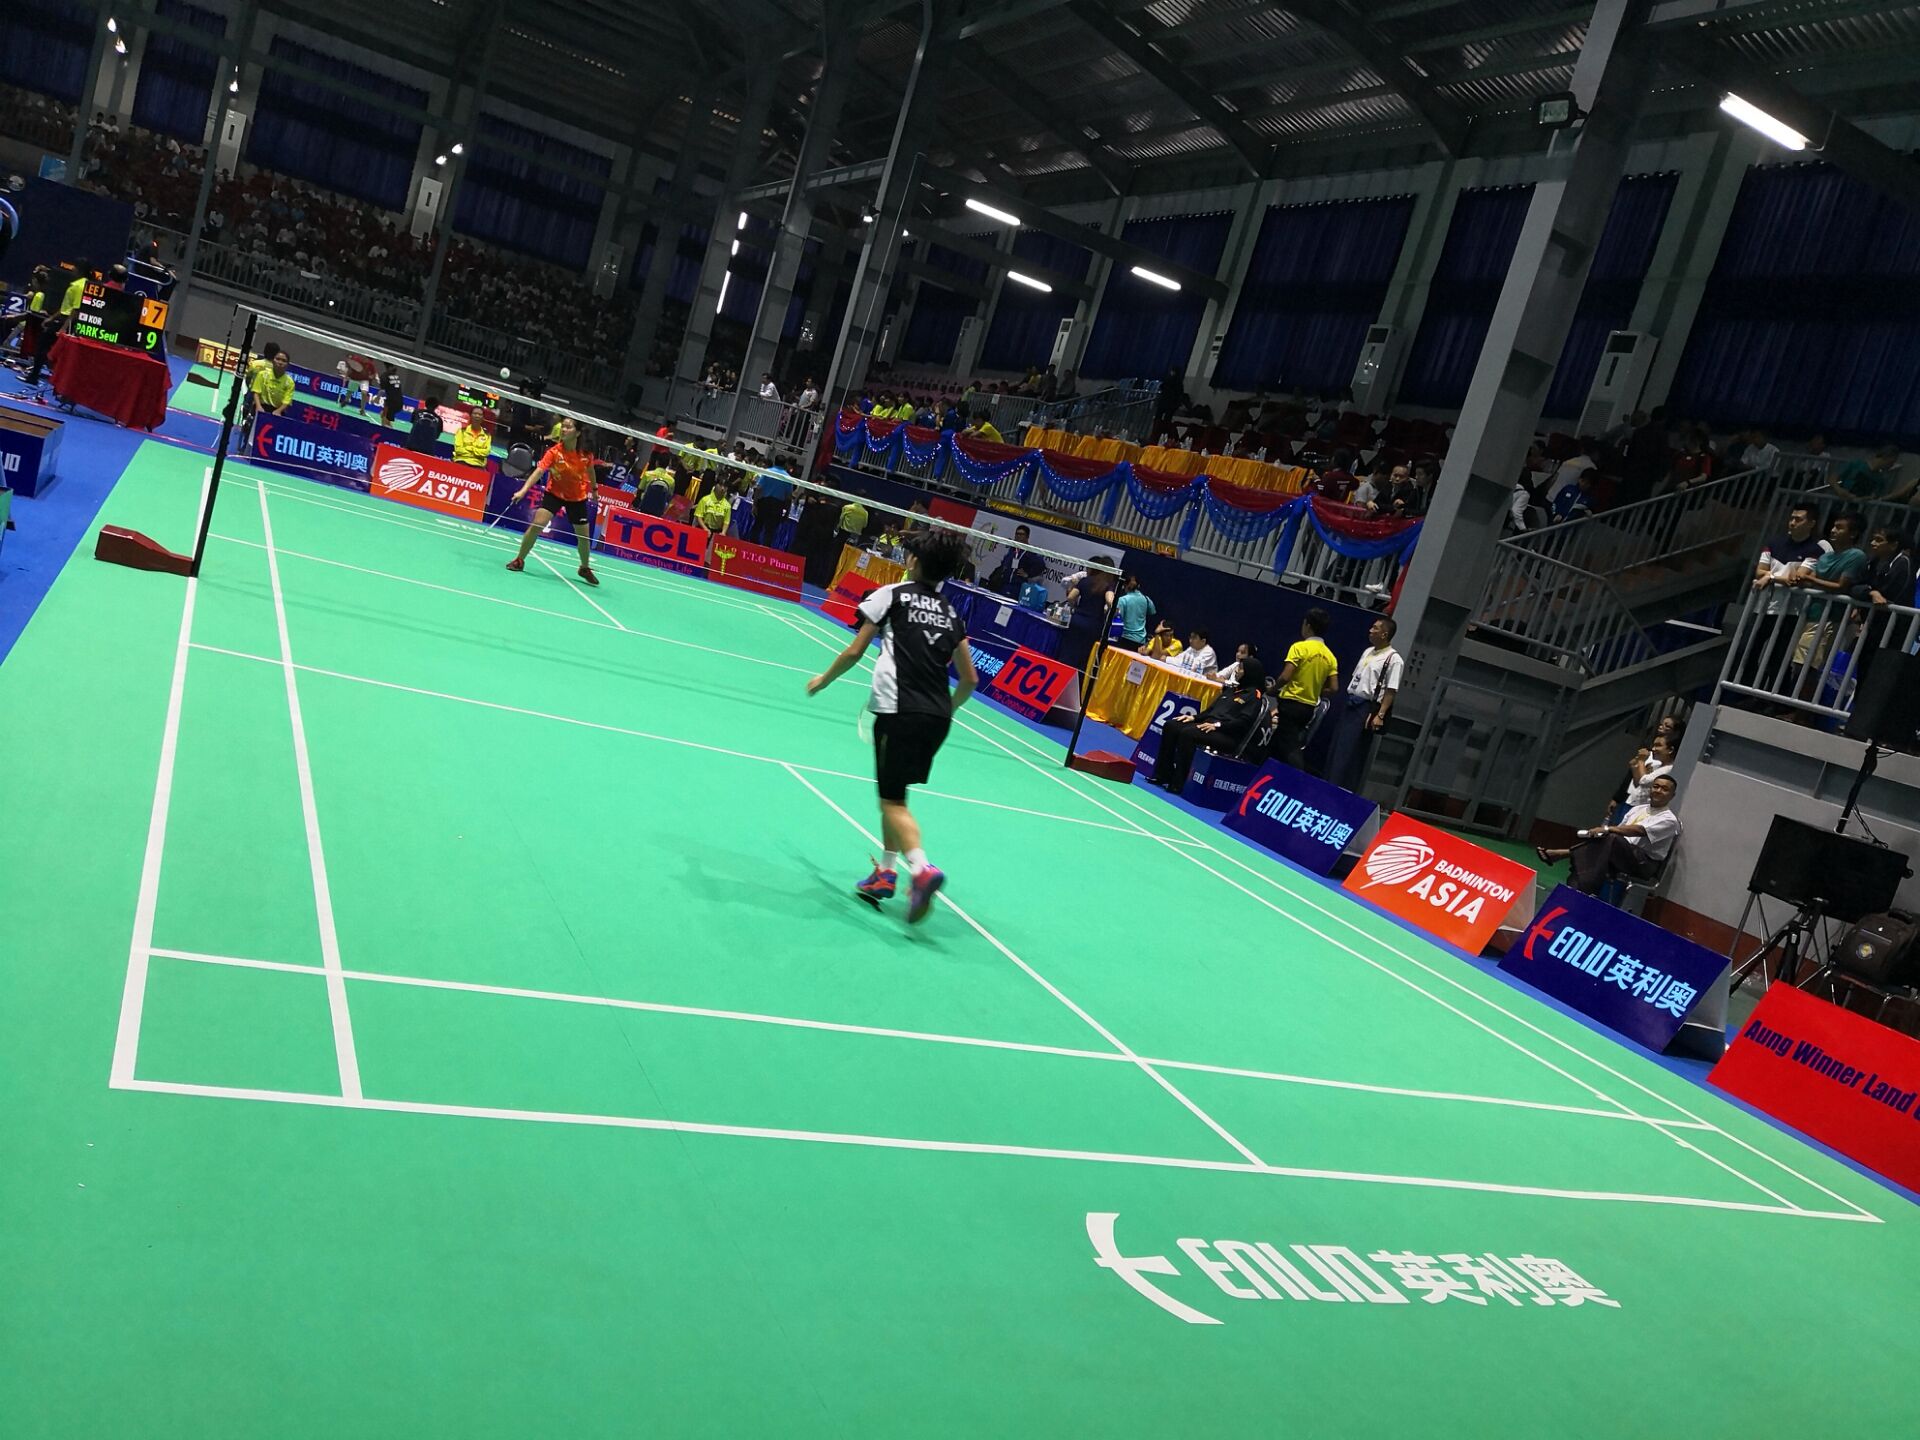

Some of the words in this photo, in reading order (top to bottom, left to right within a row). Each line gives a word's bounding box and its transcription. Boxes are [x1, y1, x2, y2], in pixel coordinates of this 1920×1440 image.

[84, 284, 99, 297] LEE
[91, 299, 106, 309] SGP
[153, 306, 163, 324] 7
[88, 315, 103, 326] KOR
[76, 322, 99, 339] PARK
[98, 329, 119, 344] Seul
[136, 332, 142, 342] 1
[145, 331, 157, 350] 9
[275, 434, 316, 461] ENLIO
[316, 445, 368, 473] 英利奥
[428, 470, 485, 492] BADMINTON
[417, 479, 471, 506] ASIA
[613, 514, 700, 562] TCL
[676, 563, 694, 575] Life
[769, 557, 799, 573] Pharm
[900, 592, 943, 613] PARK
[907, 608, 954, 631] KOREA
[1003, 655, 1058, 705] TCL
[1255, 788, 1304, 826] ENLIO
[1292, 806, 1354, 850] 英利奥
[1433, 859, 1515, 903] BADMINTON
[1407, 874, 1485, 924] ASIA
[1548, 926, 1618, 978] ENLIO
[1603, 953, 1698, 1018] 英利奥
[1744, 1019, 1794, 1057] Aung
[1791, 1039, 1867, 1088] Winner
[1861, 1073, 1918, 1114] Land
[1175, 1237, 1411, 1304] ENLIO
[1367, 1249, 1623, 1308] 英利奥
